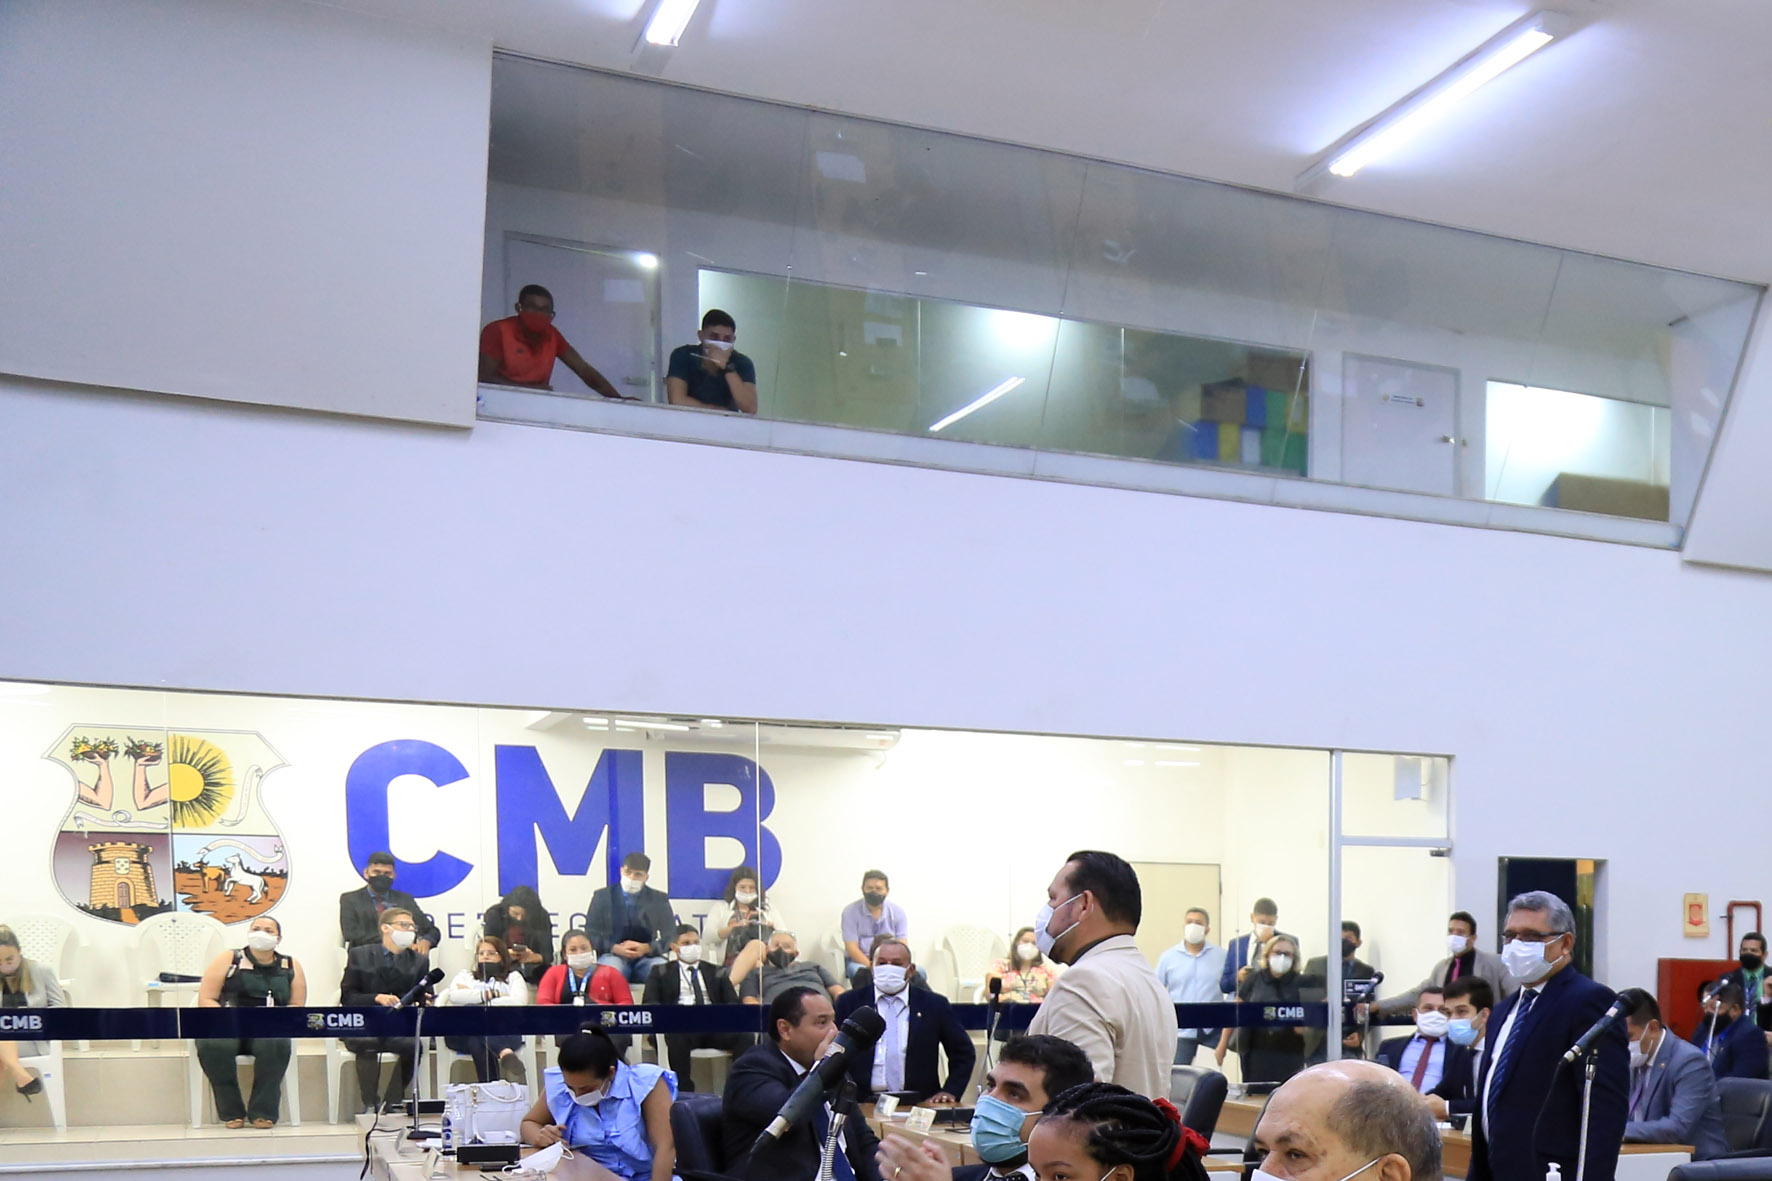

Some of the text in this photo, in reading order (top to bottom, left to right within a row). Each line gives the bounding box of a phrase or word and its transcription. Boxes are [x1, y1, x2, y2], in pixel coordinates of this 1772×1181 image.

[346, 739, 782, 899] CMB
[618, 1011, 653, 1024] CMB
[1277, 1006, 1304, 1018] CMB
[0, 1015, 43, 1030] CMB
[327, 1013, 365, 1027] CMB
